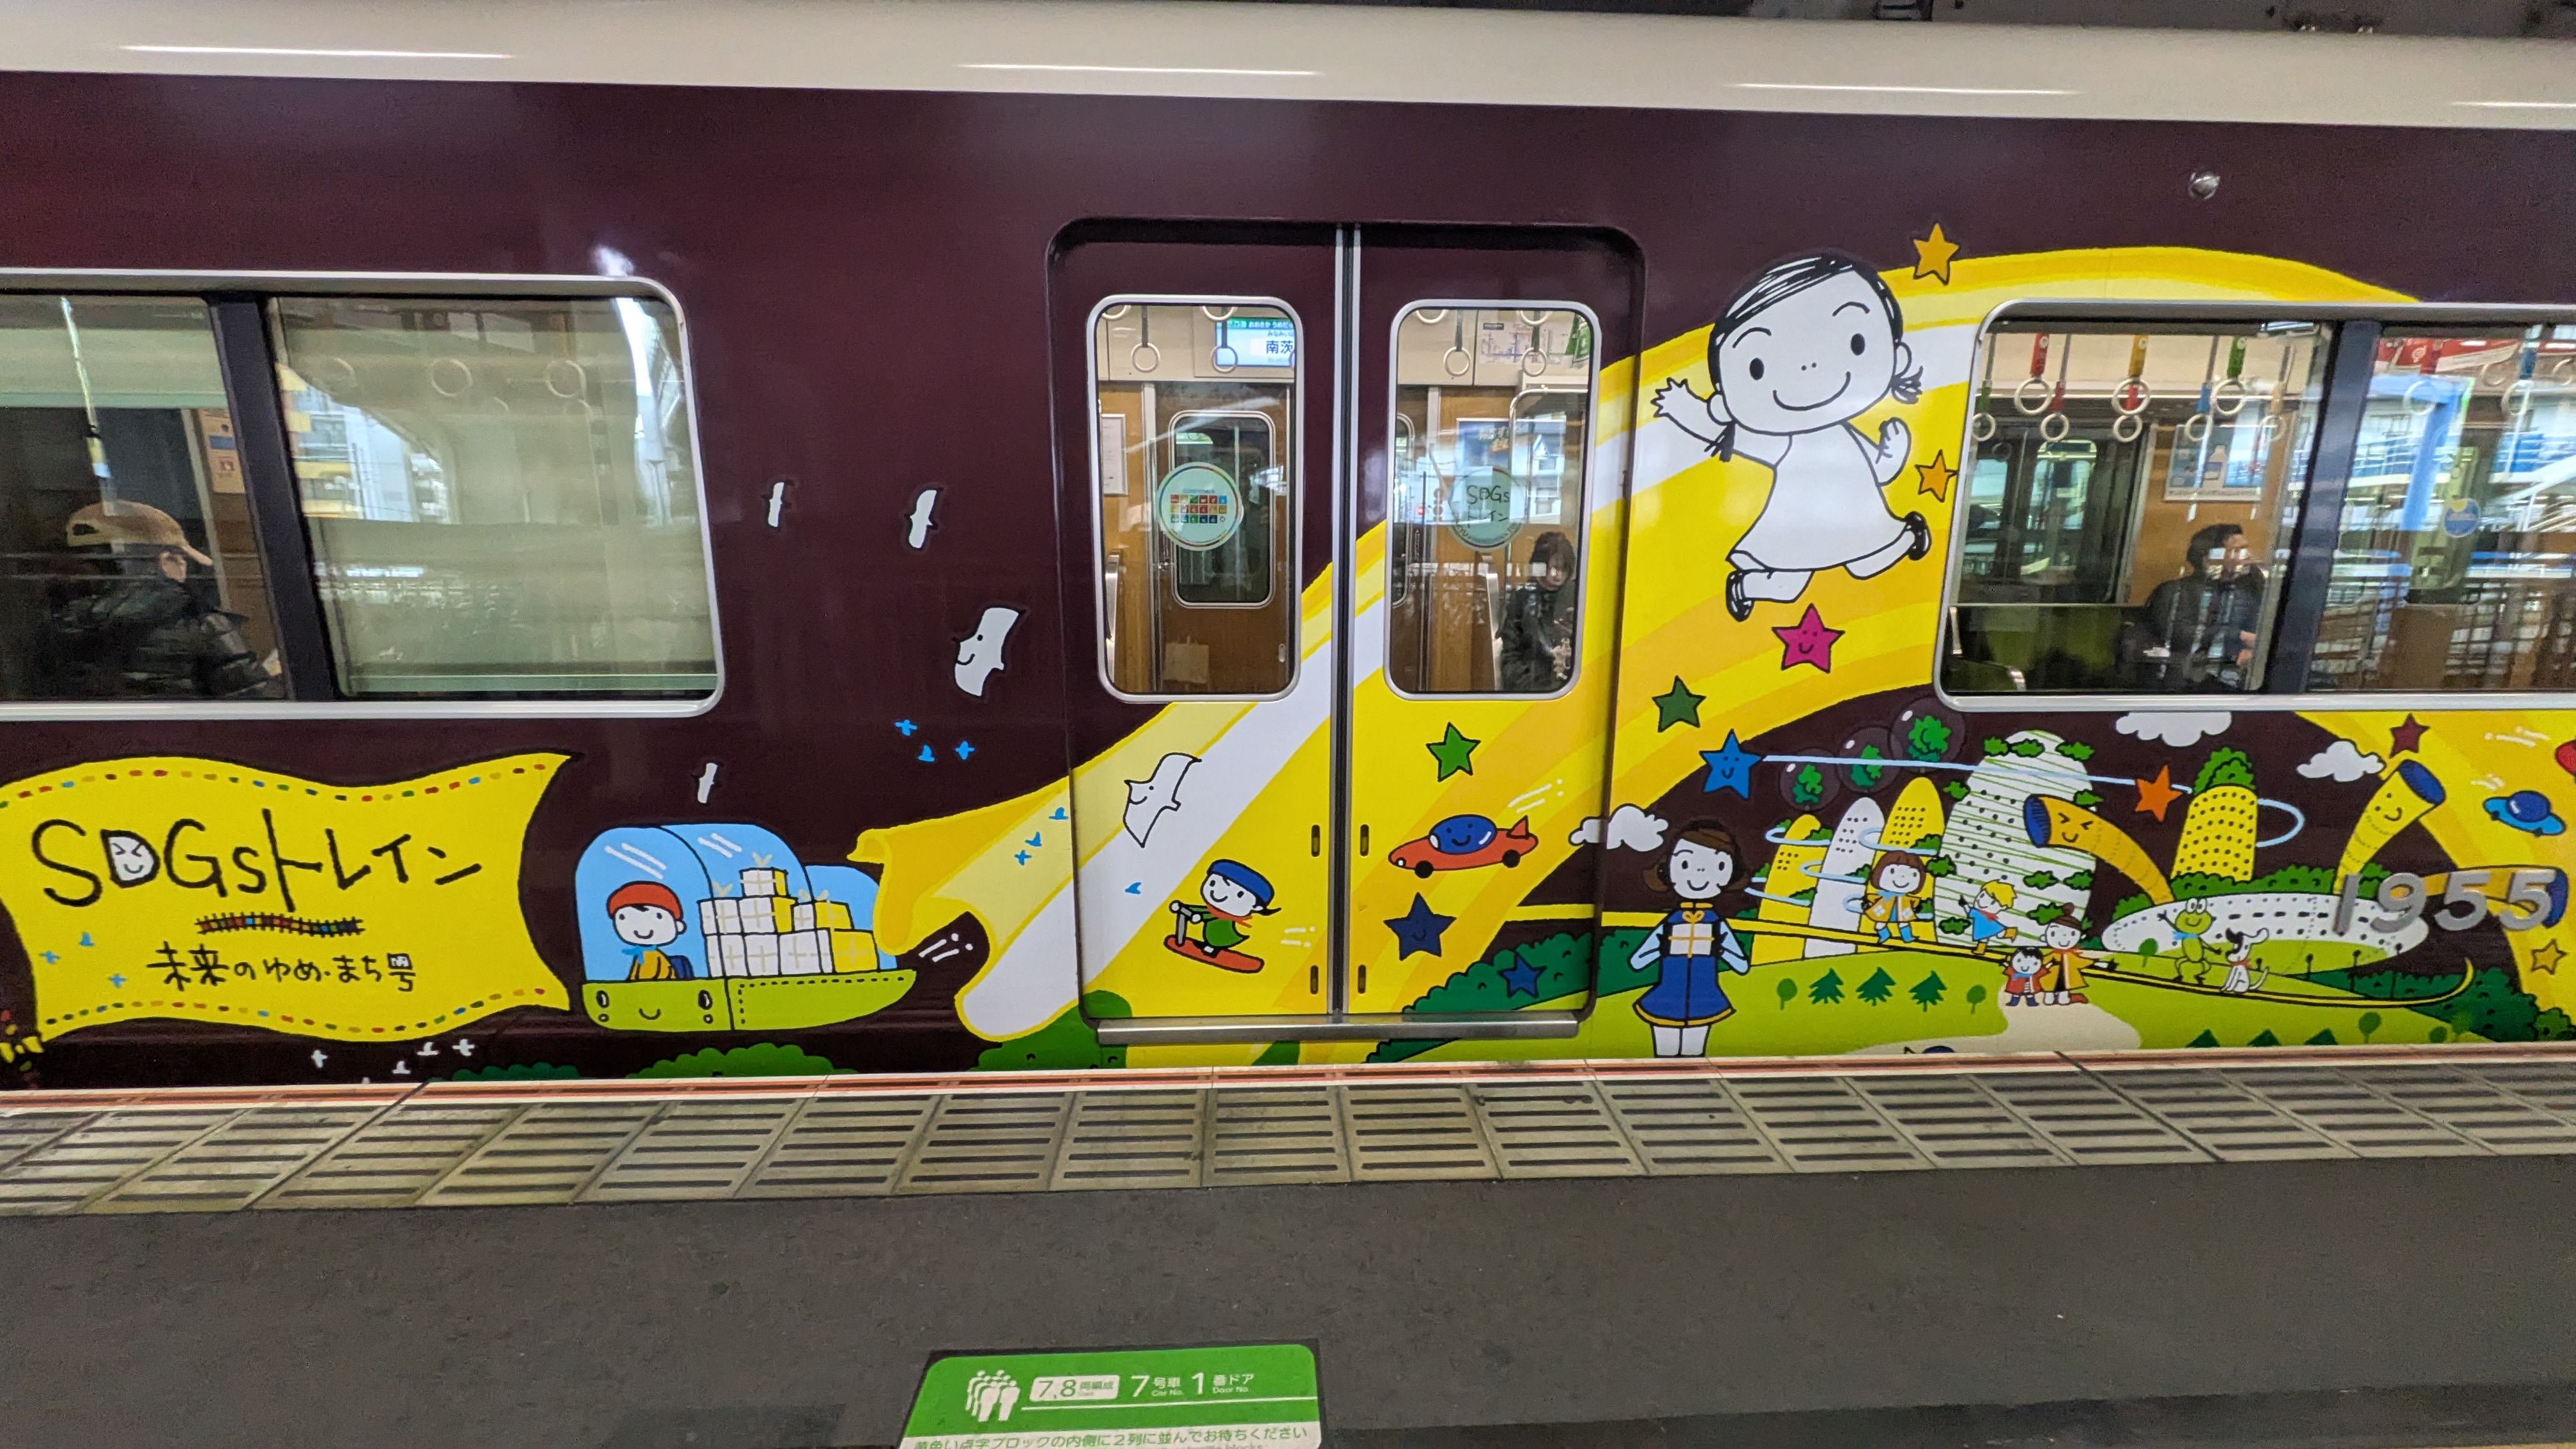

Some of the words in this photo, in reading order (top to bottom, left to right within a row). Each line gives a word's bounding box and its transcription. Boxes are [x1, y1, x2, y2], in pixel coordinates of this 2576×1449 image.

[1466, 484, 1510, 505] SDGs
[2333, 869, 2556, 935] 1955
[1131, 1375, 1150, 1398] 7
[1192, 1372, 1204, 1395] 1
